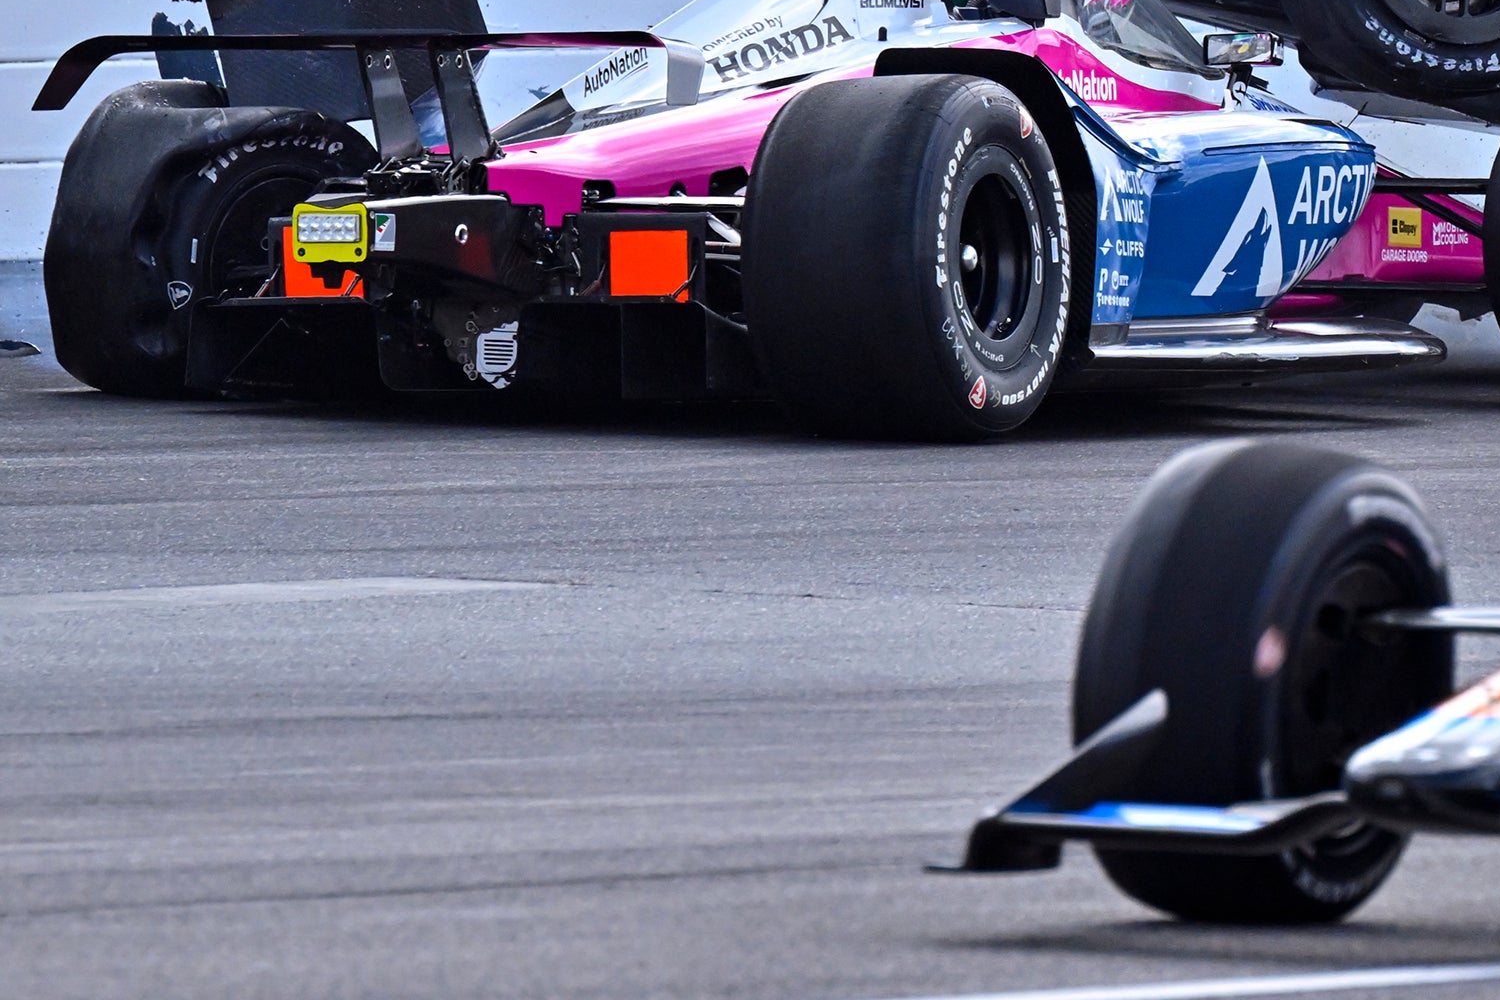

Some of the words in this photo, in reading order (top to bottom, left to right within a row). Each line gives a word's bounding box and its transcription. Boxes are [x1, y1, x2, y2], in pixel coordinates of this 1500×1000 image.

[702, 22, 765, 53] OWERED
[765, 14, 784, 28] by
[706, 15, 855, 83] HONDA
[583, 45, 649, 98] AutoNation
[936, 127, 973, 288] Firestone
[1121, 198, 1145, 223] WOLF
[1115, 239, 1145, 258] CLIFFS
[1440, 233, 1469, 245] COOLING
[1047, 168, 1071, 362] FIREHAWK
[1381, 248, 1407, 262] GARAGE
[1407, 250, 1428, 263] DOORS
[1096, 291, 1130, 308] Firestone
[1025, 361, 1050, 396] INDY
[1001, 390, 1025, 406] 500
